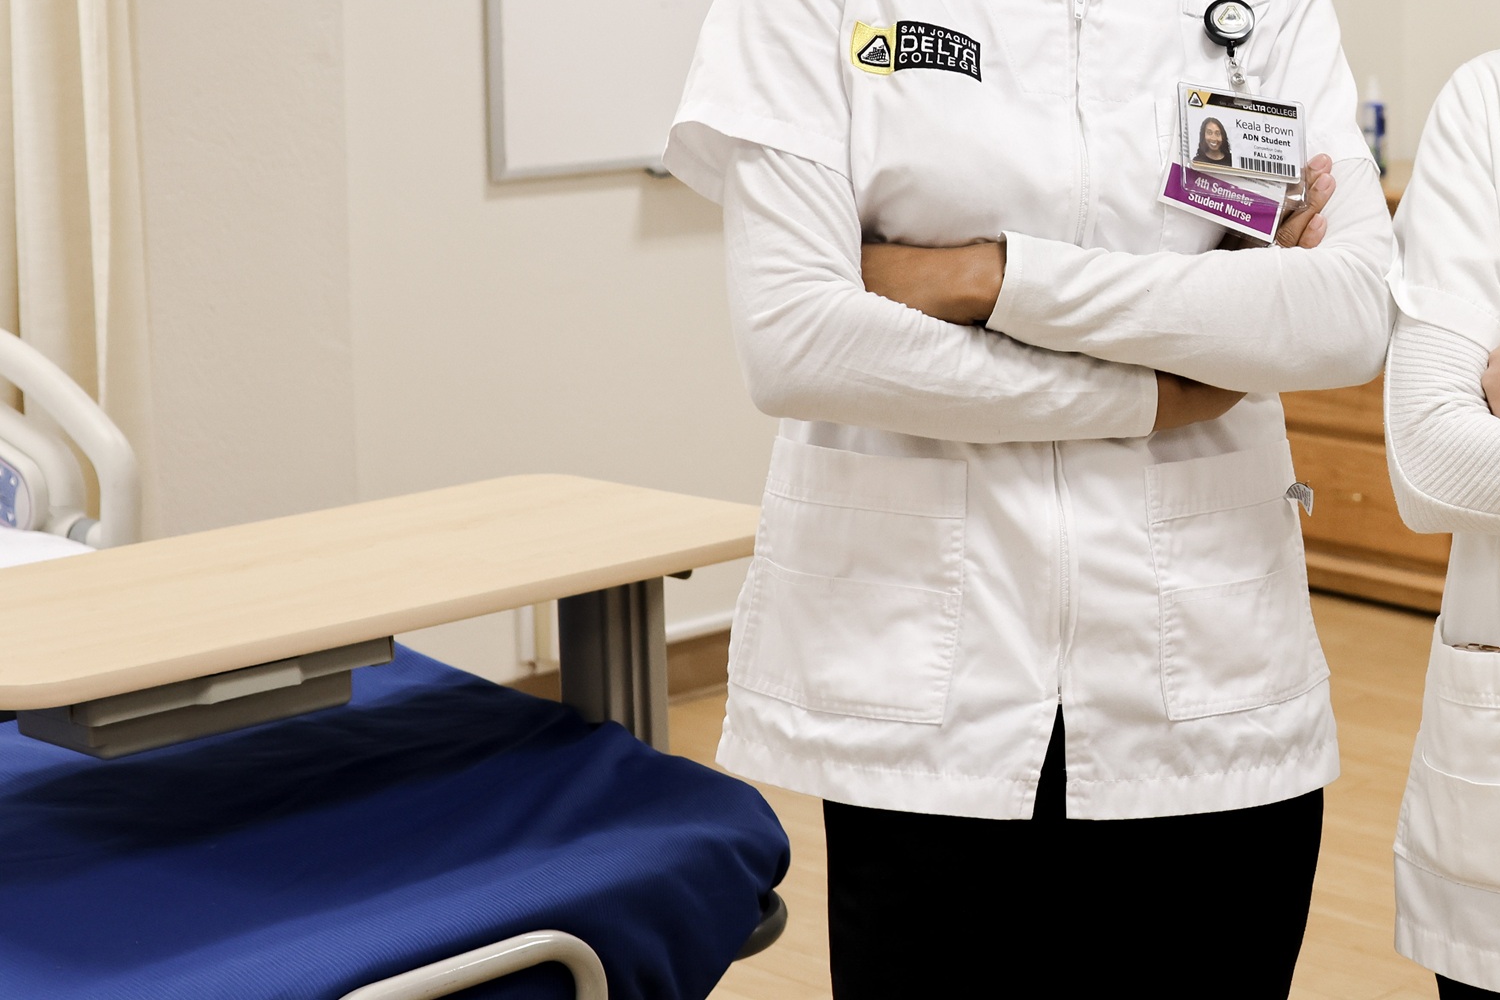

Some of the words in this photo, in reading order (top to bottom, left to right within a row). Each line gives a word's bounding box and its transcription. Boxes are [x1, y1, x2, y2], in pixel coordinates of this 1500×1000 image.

[901, 25, 925, 34] SAN
[930, 28, 977, 51] JOAQUIN
[900, 35, 976, 65] DELTA
[899, 52, 978, 75] COLLEGE
[1266, 106, 1297, 118] COLLEGE
[1235, 119, 1261, 132] Keala
[1264, 123, 1294, 137] Brown
[1242, 133, 1259, 142] ADN
[1261, 134, 1291, 147] Student
[1253, 151, 1267, 159] FALL
[1269, 153, 1284, 161] 2026
[1194, 177, 1210, 190] 4th
[1211, 182, 1254, 207] Semester
[1188, 193, 1223, 213] Student
[1225, 204, 1252, 222] Nurse
